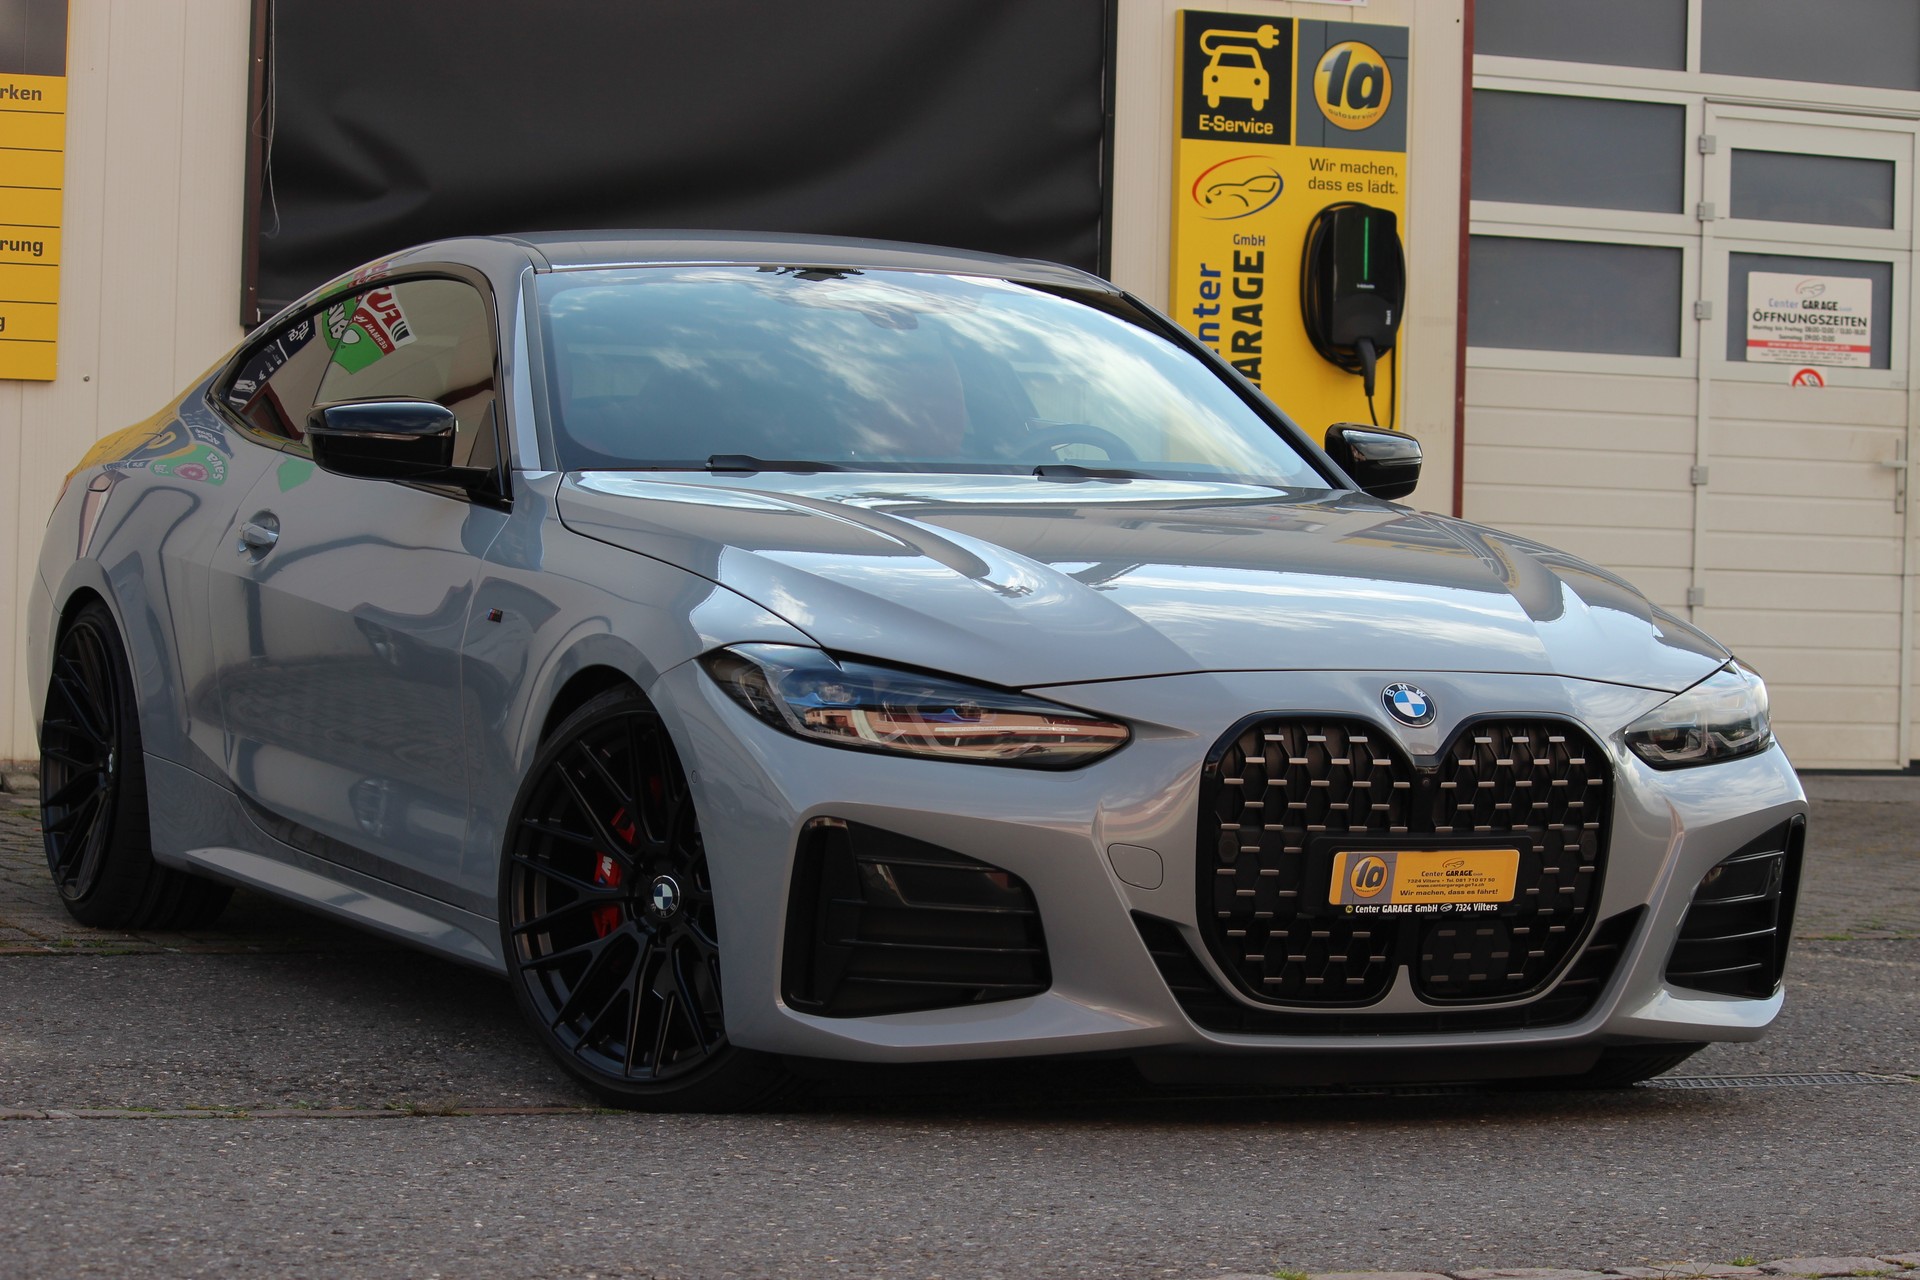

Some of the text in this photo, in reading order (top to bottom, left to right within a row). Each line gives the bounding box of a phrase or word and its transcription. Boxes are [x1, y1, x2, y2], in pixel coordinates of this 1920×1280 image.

[1322, 50, 1384, 110] 1a
[0, 84, 42, 101] rken
[1199, 113, 1274, 135] E-Service
[1309, 157, 1398, 178] Wir machen,
[1308, 176, 1399, 195] dass es lädt.
[0, 239, 44, 257] rung
[1233, 233, 1266, 246] GmbH
[1768, 298, 1799, 309] Center
[1802, 300, 1838, 311] GARAGE
[1231, 250, 1265, 390] ARAGE
[1752, 308, 1867, 327] ÖFFNUNGSZEITEN
[1385, 684, 1426, 698] BMW
[1356, 860, 1385, 888] 1a
[1355, 904, 1380, 913] Center
[1382, 904, 1413, 913] GARAGE
[1415, 904, 1438, 913] GmbH
[1455, 903, 1472, 912] 7324
[1473, 902, 1498, 911] Vilters
